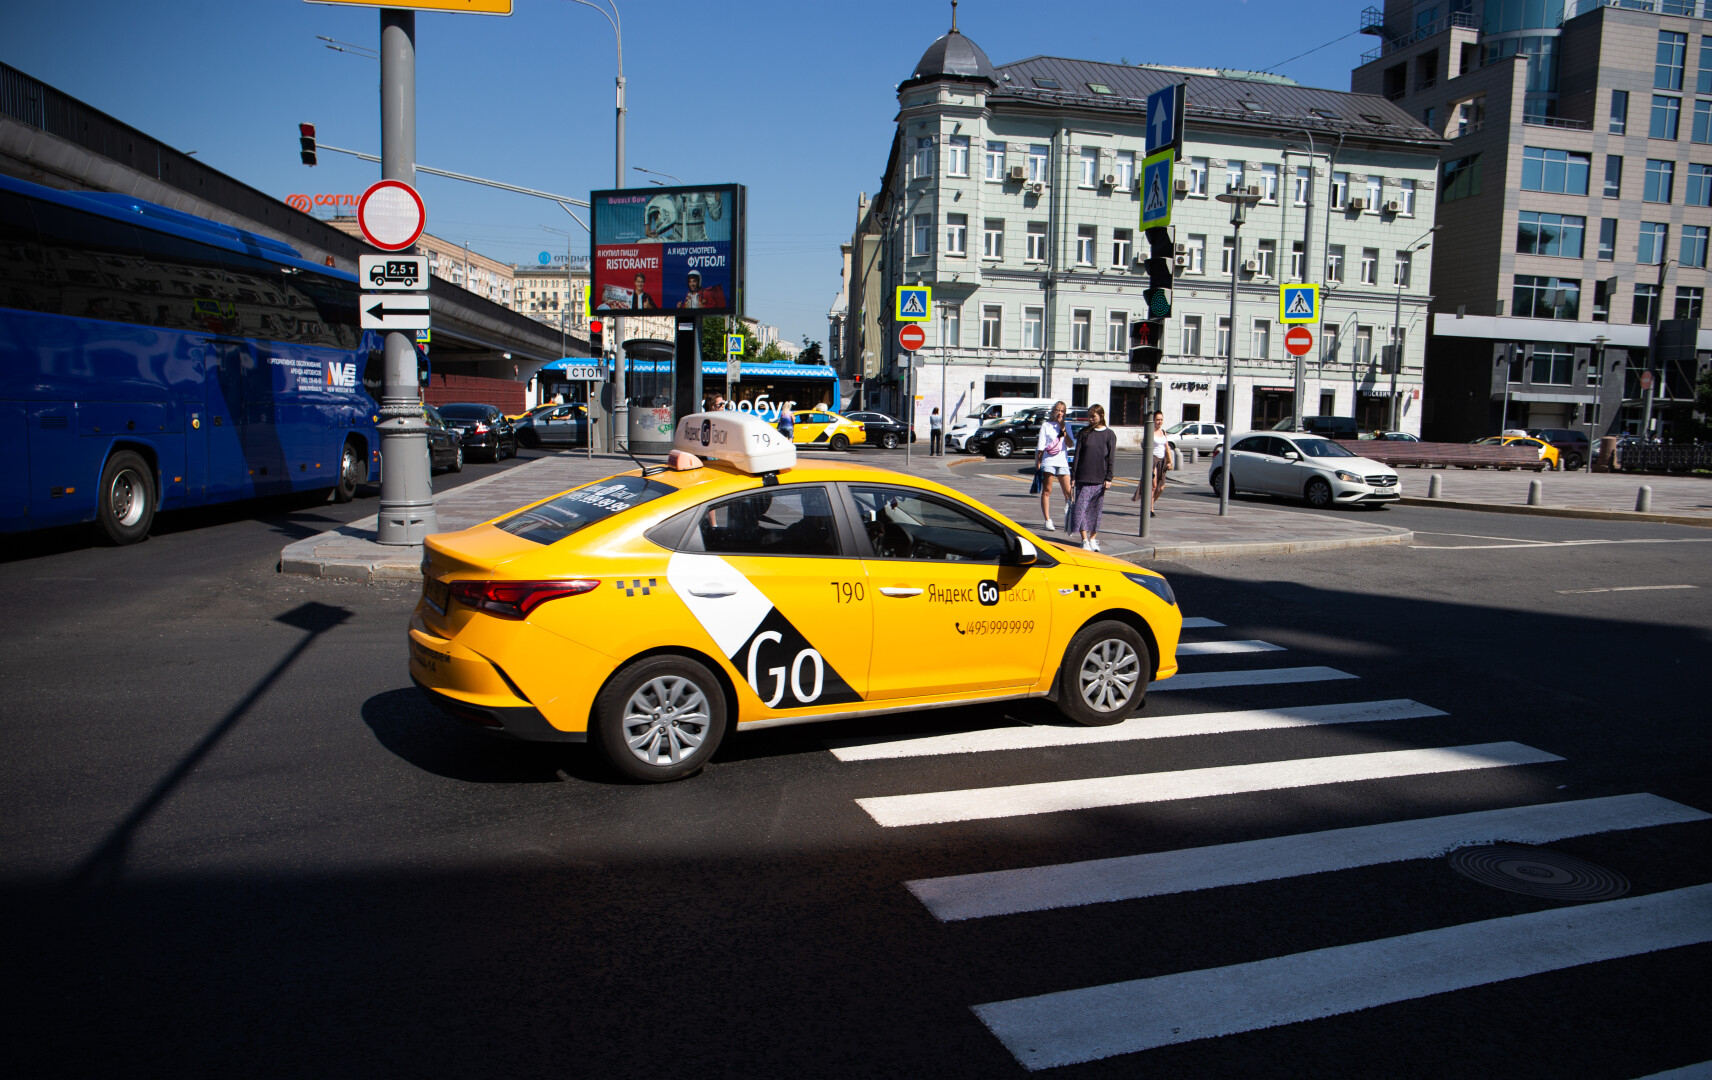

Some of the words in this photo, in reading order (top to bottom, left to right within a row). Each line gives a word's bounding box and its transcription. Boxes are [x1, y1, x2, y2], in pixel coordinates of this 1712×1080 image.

[601, 249, 620, 257] КУПИЛ
[620, 249, 640, 257] ПИЦЦУ
[677, 247, 689, 256] ИДУ
[688, 246, 717, 255] СМОТРЕТЬ
[606, 257, 659, 270] RISTORANTE!
[687, 256, 726, 268] ФУТБОЛ!
[390, 264, 407, 276] 2,5
[572, 368, 603, 378] СТОП
[830, 581, 865, 604] 790
[928, 583, 974, 604] Яндекс
[978, 582, 998, 602] Go
[1001, 583, 1036, 602] Такси
